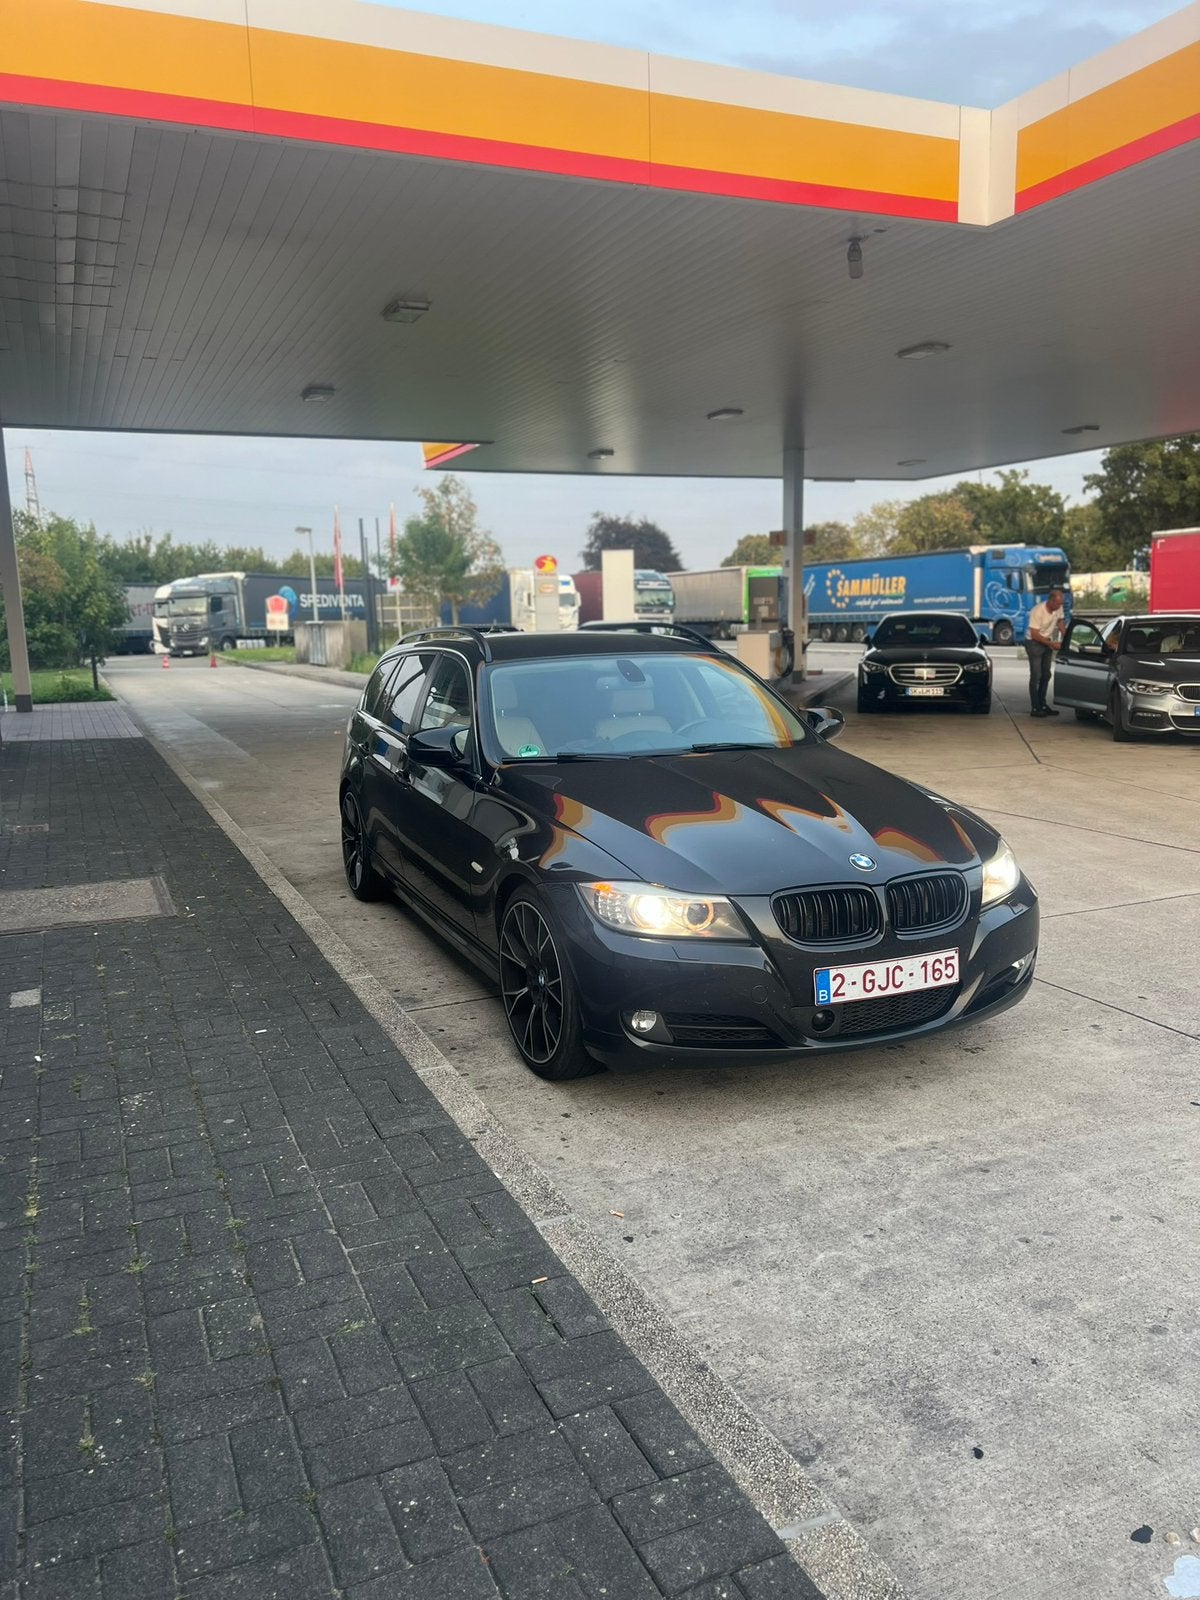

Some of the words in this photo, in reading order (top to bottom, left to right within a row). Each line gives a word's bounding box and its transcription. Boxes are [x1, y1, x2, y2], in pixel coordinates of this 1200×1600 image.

[837, 573, 907, 597] SAMMÜLLER
[819, 990, 829, 1001] B
[832, 955, 956, 998] 2-GJC-165
